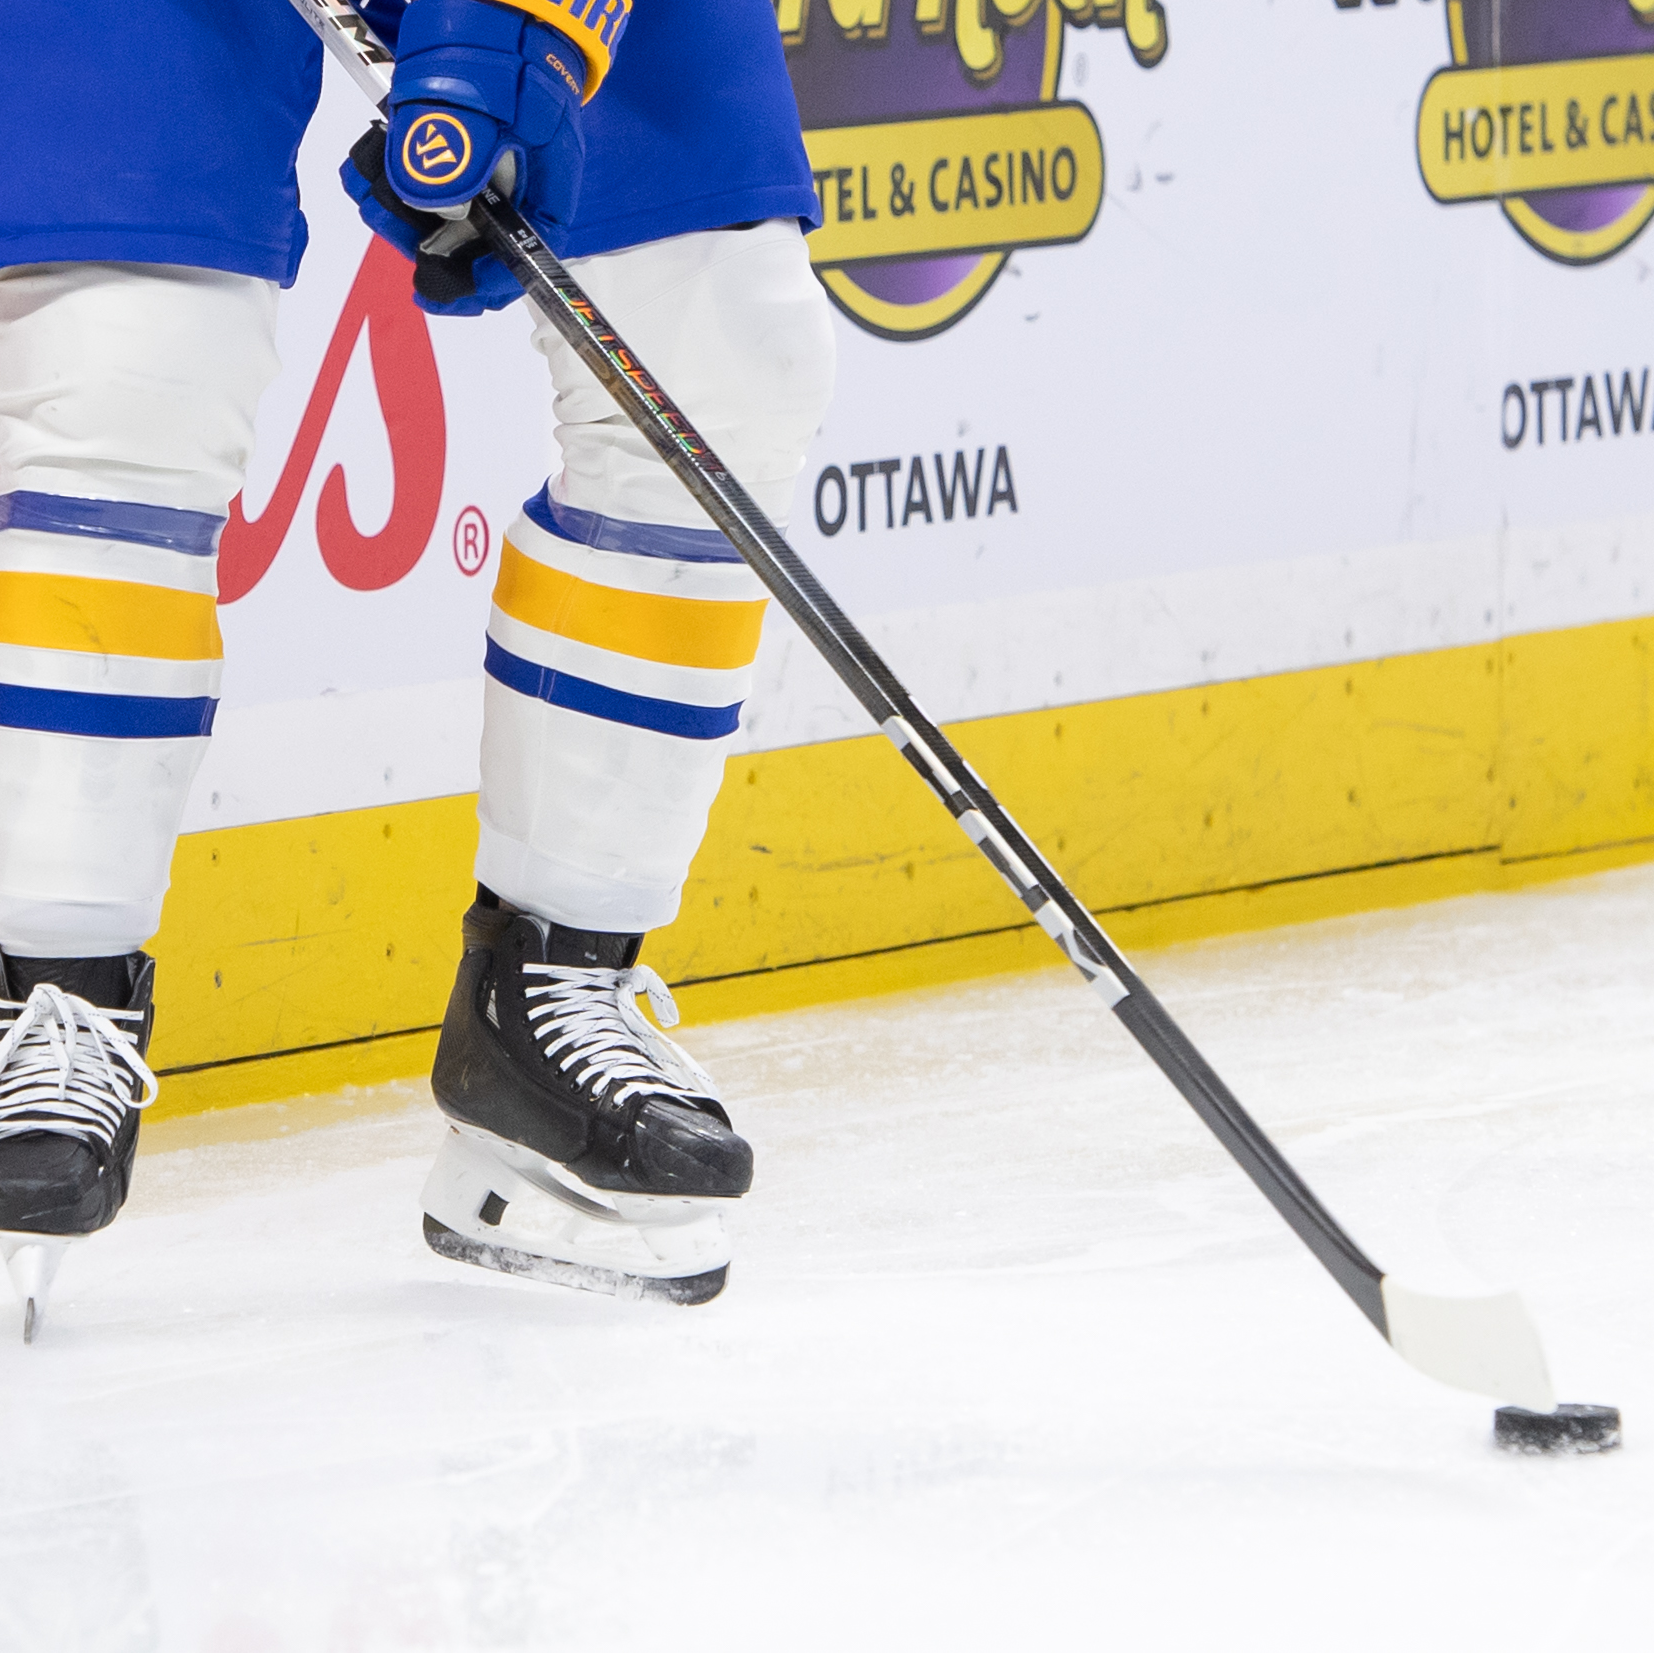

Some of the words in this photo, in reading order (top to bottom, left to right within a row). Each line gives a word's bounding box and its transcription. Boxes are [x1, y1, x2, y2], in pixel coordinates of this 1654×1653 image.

[546, 52, 580, 96] COVERT
[1442, 103, 1556, 164] HOTEL
[1565, 98, 1590, 150] &
[889, 161, 916, 217] &
[929, 145, 1077, 213] CASINO
[815, 445, 1019, 538] OTTAWA
